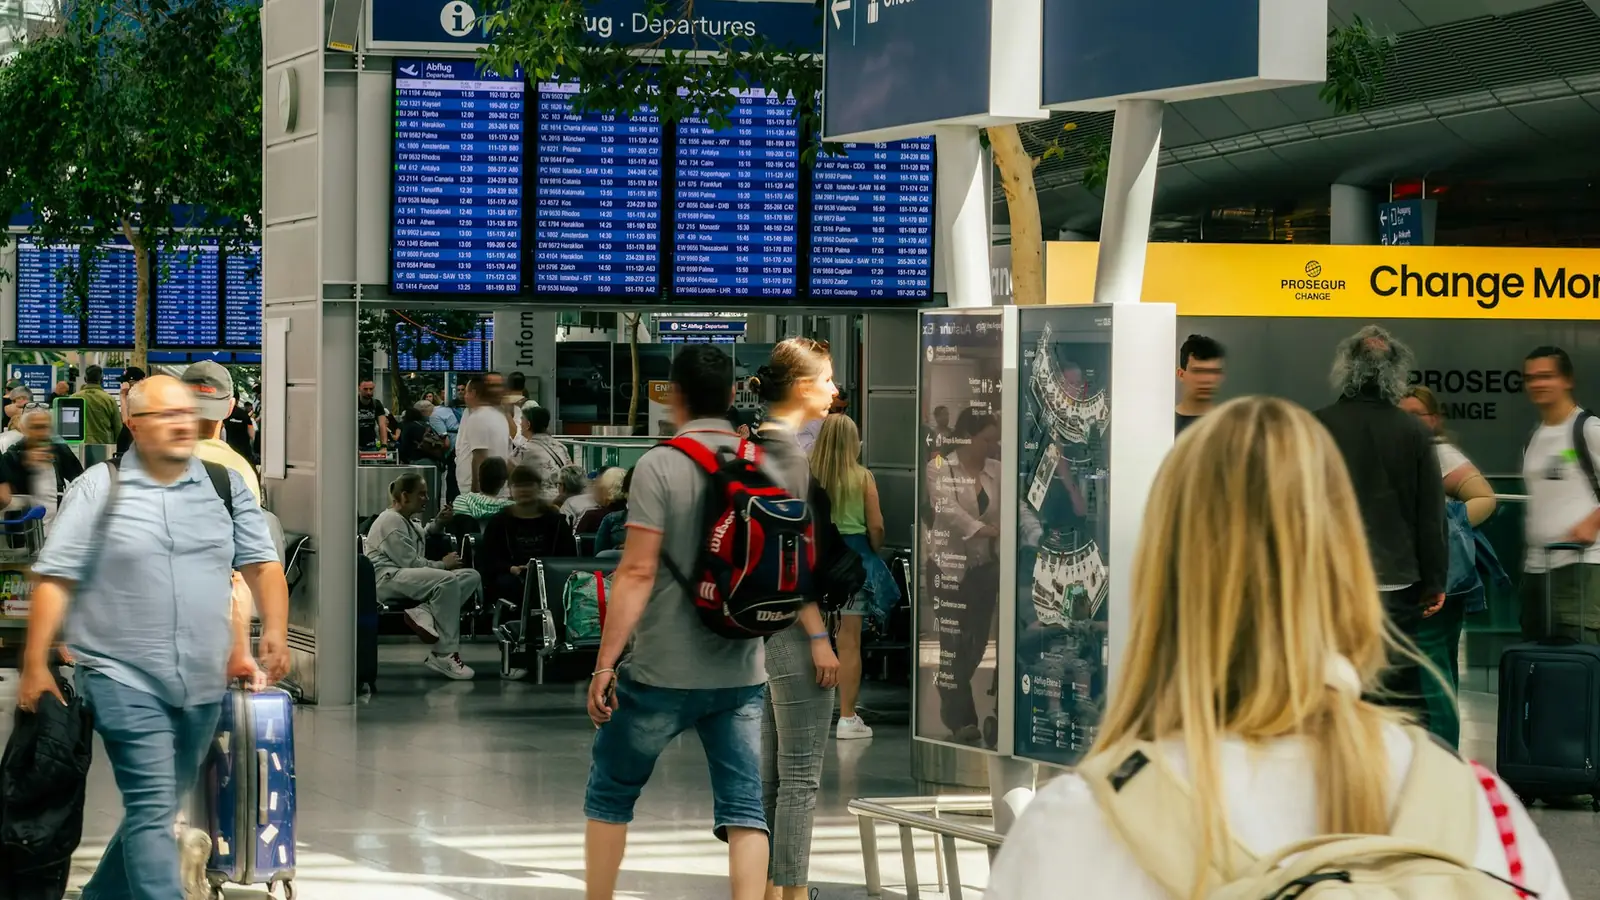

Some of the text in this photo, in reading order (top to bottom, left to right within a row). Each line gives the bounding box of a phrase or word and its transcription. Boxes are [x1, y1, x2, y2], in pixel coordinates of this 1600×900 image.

[632, 12, 756, 38] Departures
[426, 63, 452, 73] Abflug
[1281, 279, 1346, 290] PROSEGUR
[1370, 264, 1600, 309] Change Mo
[1407, 370, 1523, 393] PROSEG
[1440, 402, 1496, 420] ANGE
[1034, 676, 1046, 686] Abflug
